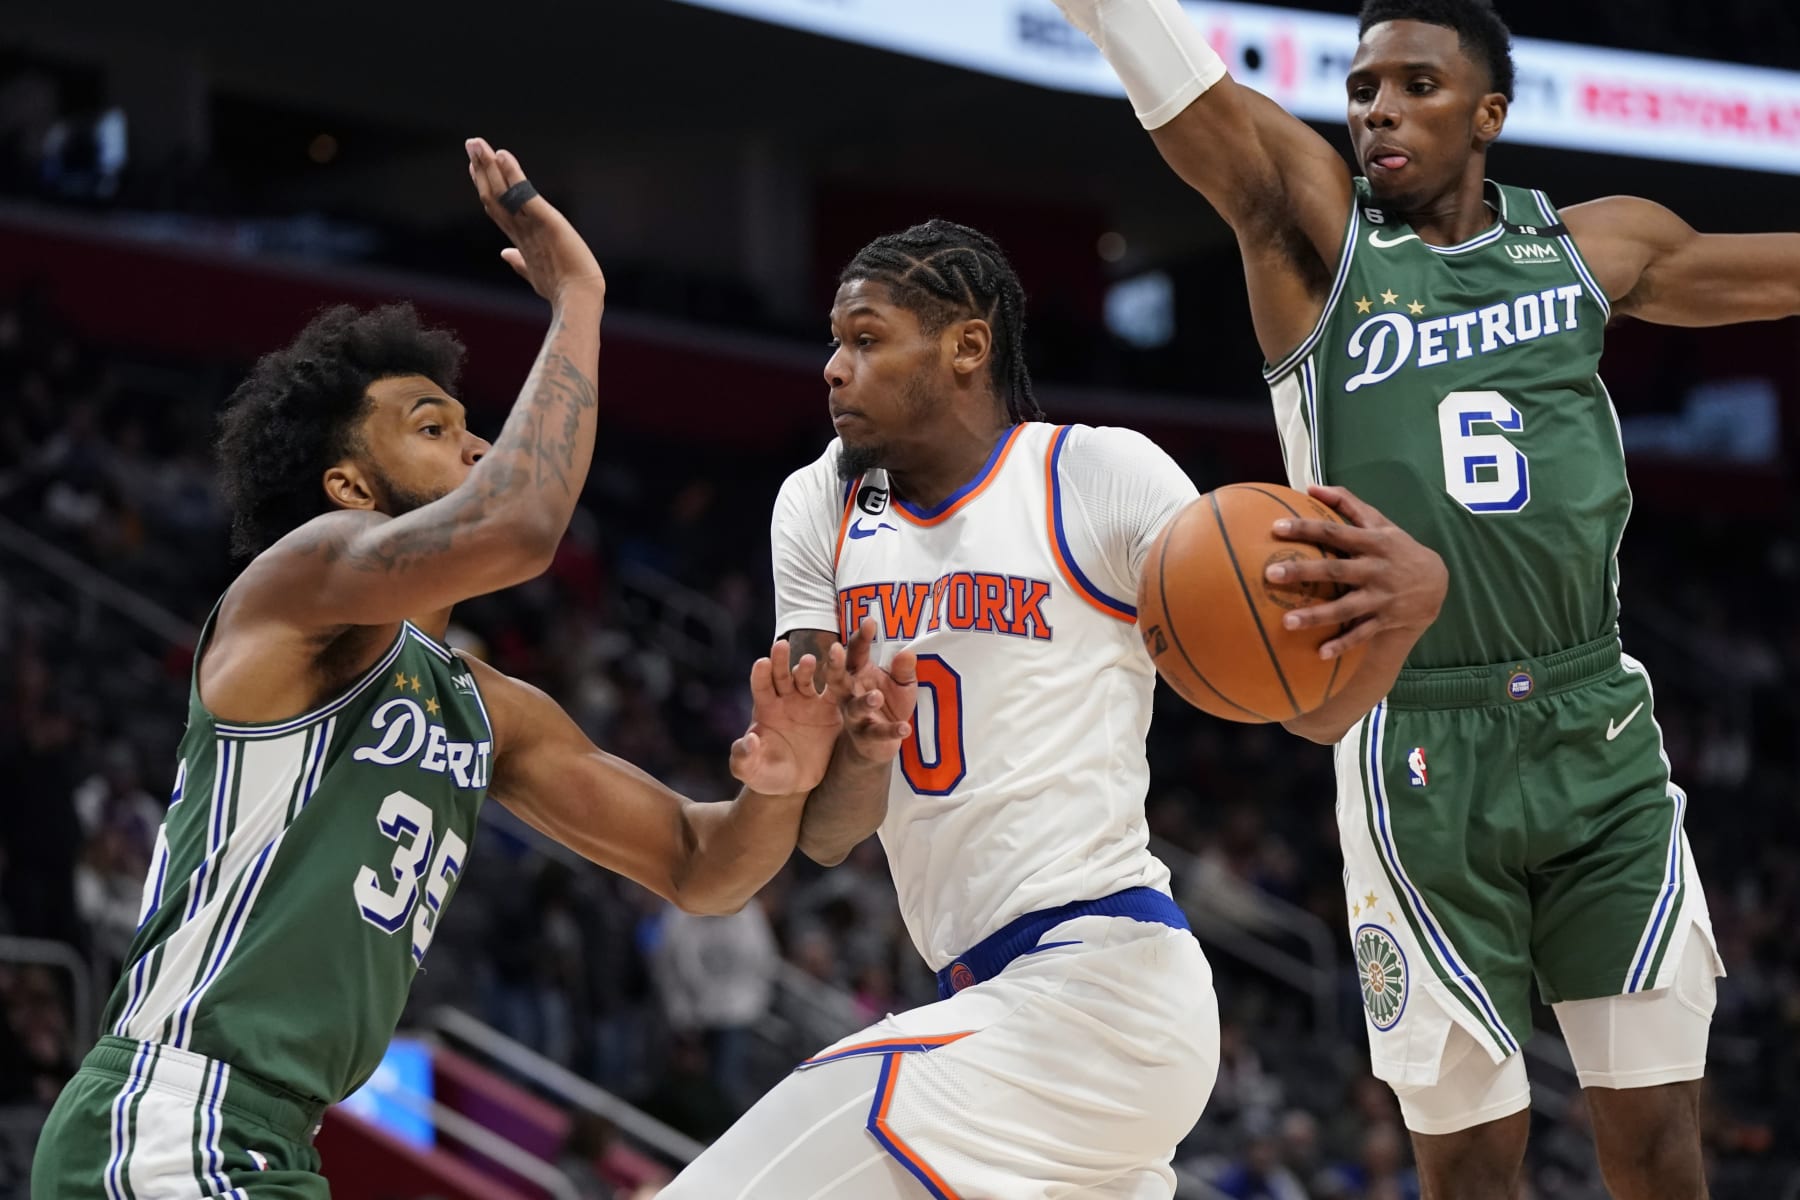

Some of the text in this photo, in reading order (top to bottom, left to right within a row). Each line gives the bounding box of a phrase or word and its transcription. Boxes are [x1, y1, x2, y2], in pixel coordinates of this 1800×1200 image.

[1364, 207, 1385, 224] 6
[1504, 243, 1558, 259] UWM
[1343, 283, 1583, 393] DETROIT
[1437, 390, 1532, 515] 6
[927, 571, 1054, 642] YORK
[899, 653, 967, 796] 0
[353, 790, 468, 968] 35
